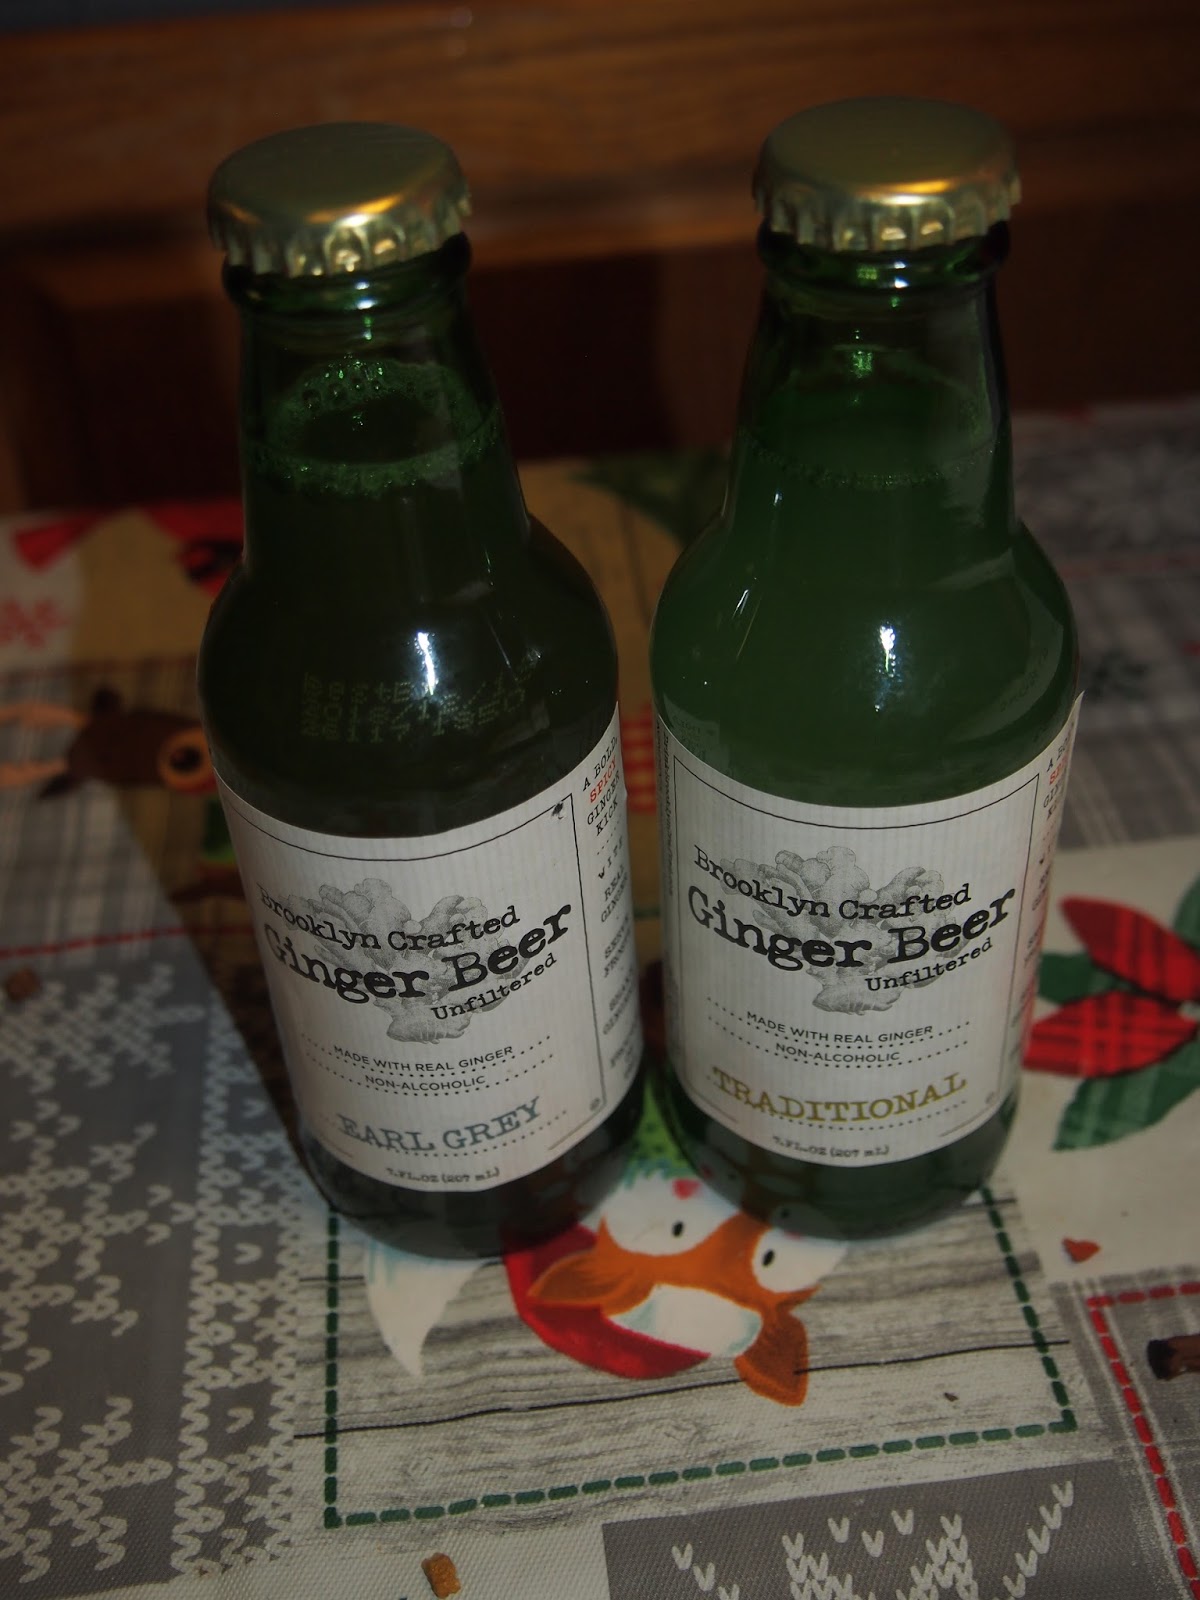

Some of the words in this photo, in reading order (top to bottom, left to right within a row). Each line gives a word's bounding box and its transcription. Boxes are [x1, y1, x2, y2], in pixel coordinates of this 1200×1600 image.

[583, 777, 591, 792] A
[590, 754, 616, 804] SPICY
[596, 794, 618, 837] KICK
[694, 844, 831, 918] Brooklyn
[839, 882, 972, 921] Crafted
[257, 882, 381, 951] Brooklyn
[387, 905, 520, 951] Crafted
[688, 884, 873, 972] Ginger
[886, 888, 1017, 965] Beer
[264, 923, 430, 1004] Ginger
[441, 904, 572, 993] Beer
[864, 937, 994, 992] Unfiltered
[431, 953, 557, 1021] Unfiltered
[747, 1010, 786, 1033] MADE
[790, 1026, 829, 1042] WITH
[834, 1032, 873, 1043] REAL
[878, 1025, 933, 1043] GINGER
[775, 1042, 901, 1063] NON-ALCOHOLIC
[333, 1045, 370, 1065] MADE
[374, 1058, 411, 1072] WITH
[416, 1061, 455, 1073] REAL
[459, 1045, 514, 1069] GINGER
[365, 1074, 487, 1092] NON-ALCOHOLIC
[711, 1066, 968, 1122] TRADITIONAL
[337, 1113, 436, 1152] EARL
[442, 1095, 541, 1151] GREY
